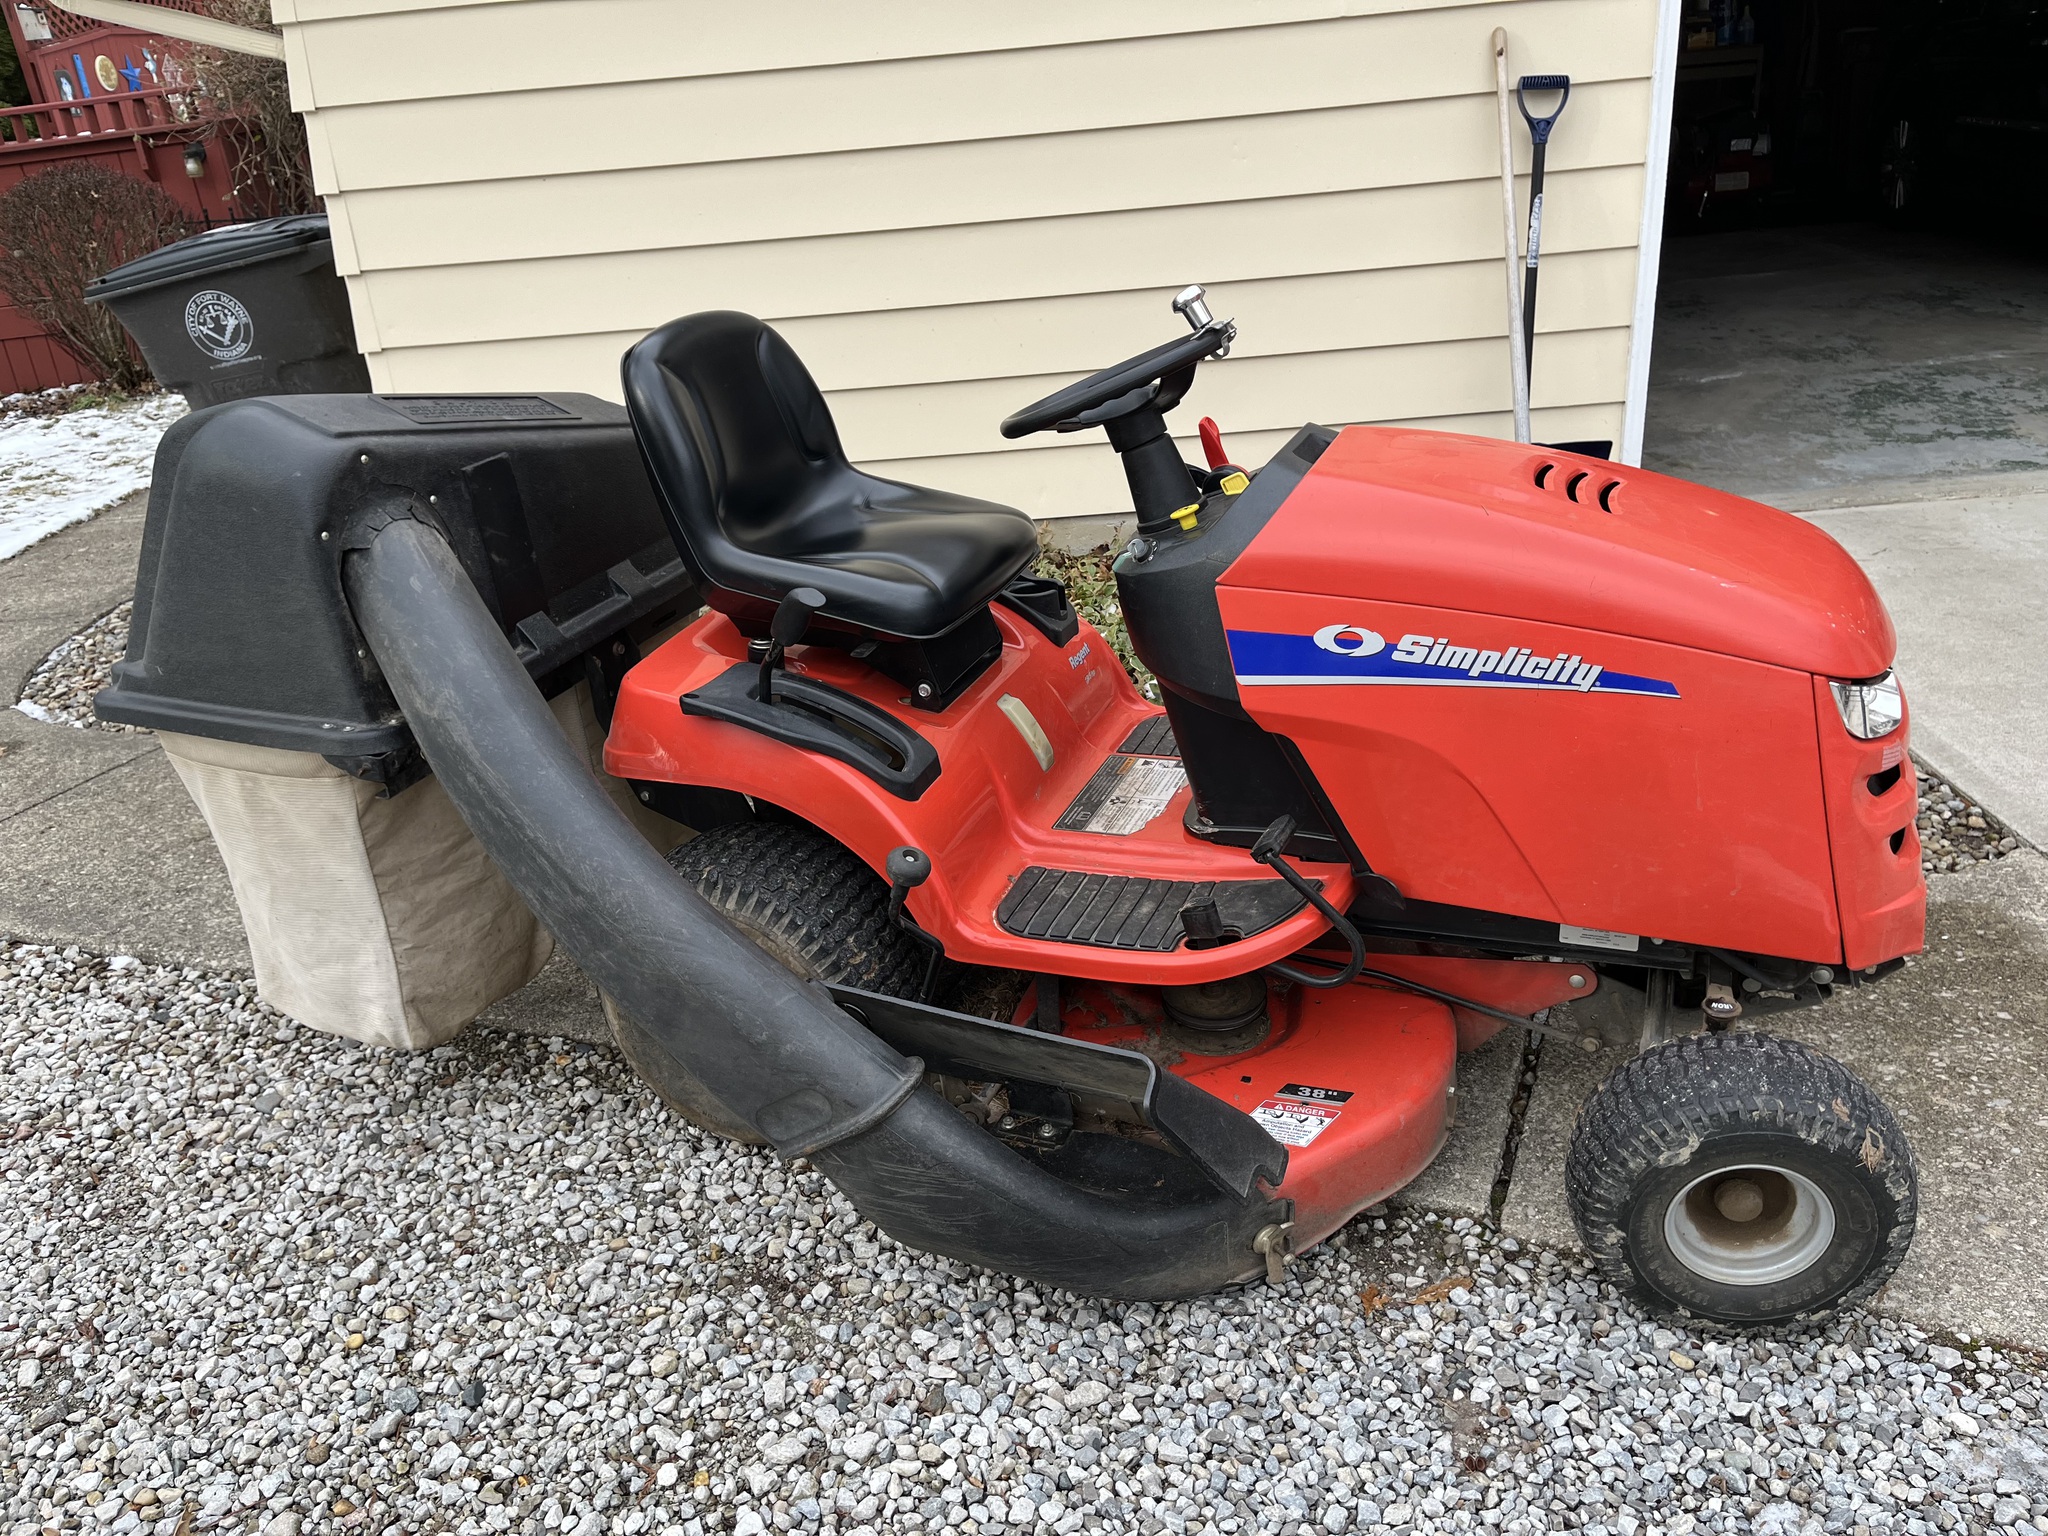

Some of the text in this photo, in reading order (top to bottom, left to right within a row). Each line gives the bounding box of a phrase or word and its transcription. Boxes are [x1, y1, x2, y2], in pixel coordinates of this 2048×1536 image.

[196, 293, 218, 306] FORT
[188, 303, 198, 316] OF
[220, 295, 249, 325] WAYNE
[188, 315, 199, 337] CITY
[213, 342, 248, 358] INDIANA
[1068, 642, 1091, 670] Regent
[1391, 632, 1604, 693] Simplicity
[1297, 1086, 1338, 1099] 38"
[1285, 1105, 1325, 1116] DANGER
